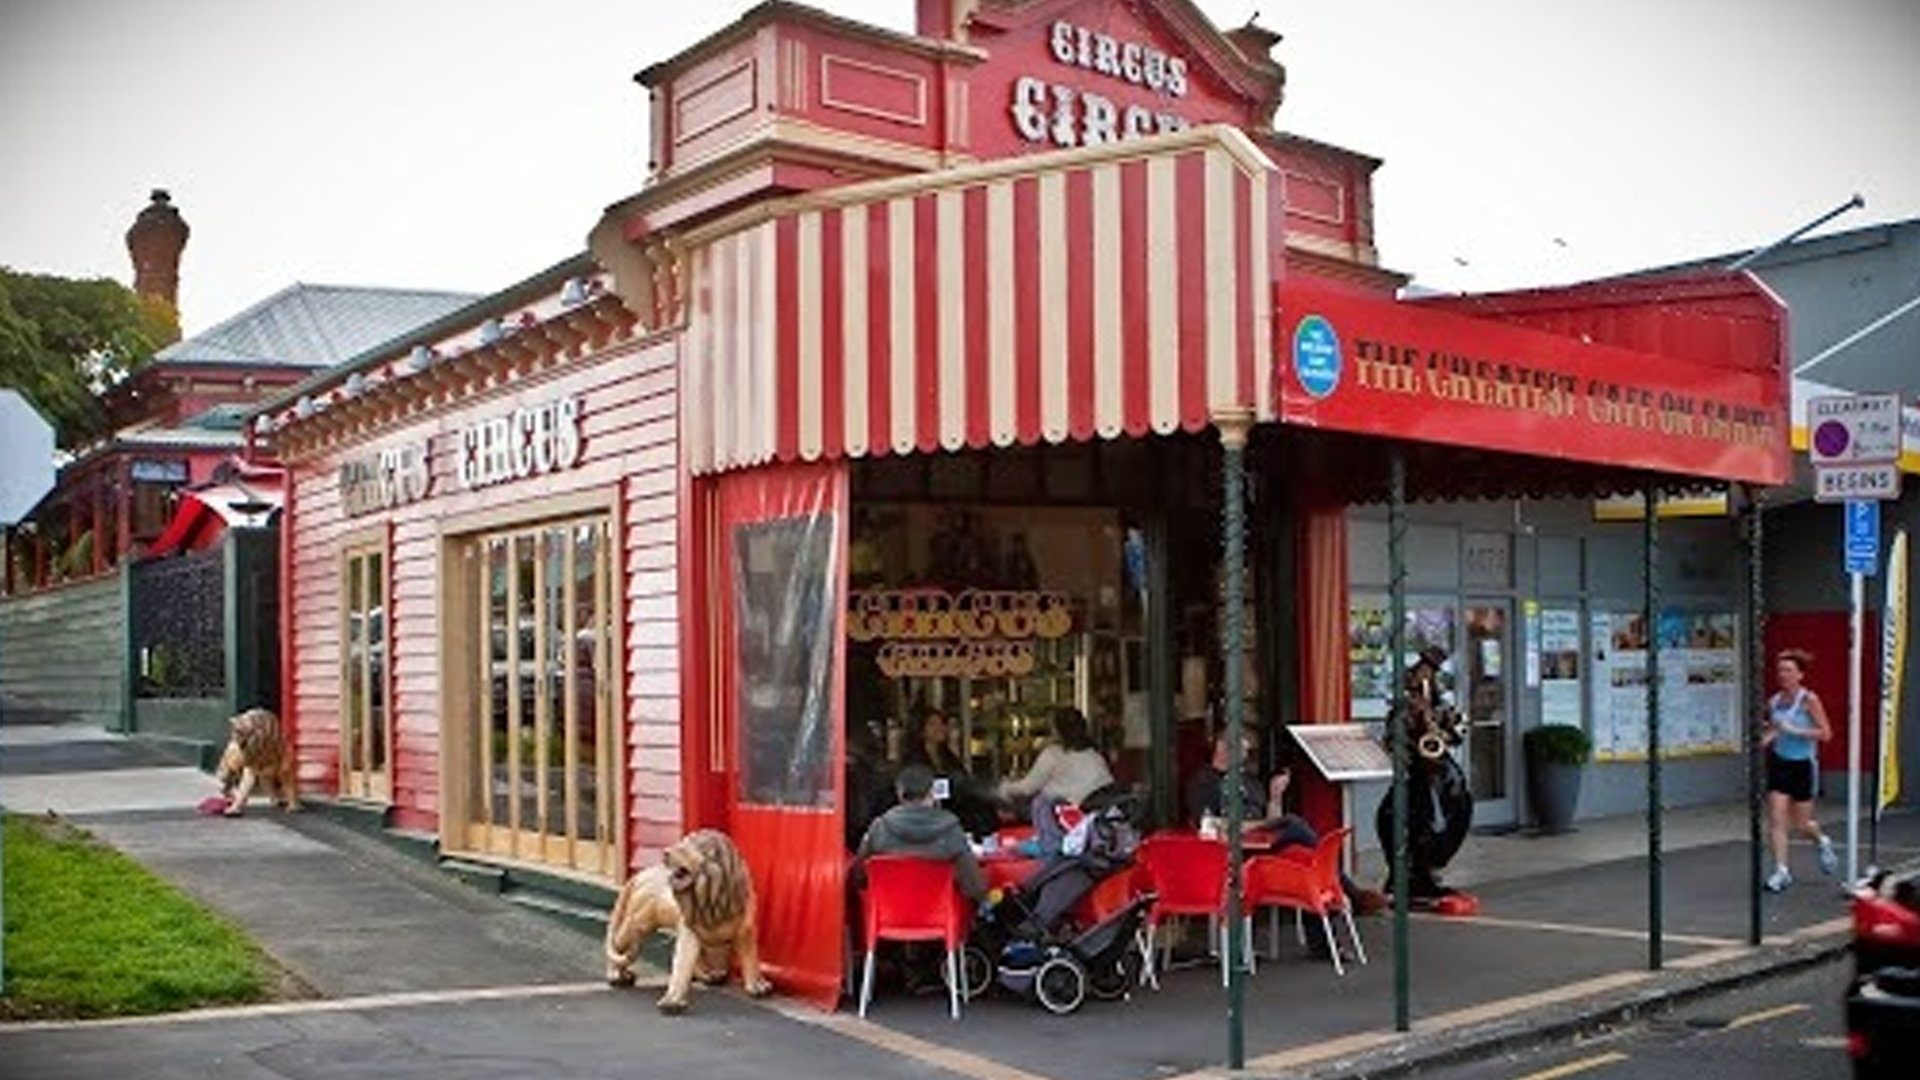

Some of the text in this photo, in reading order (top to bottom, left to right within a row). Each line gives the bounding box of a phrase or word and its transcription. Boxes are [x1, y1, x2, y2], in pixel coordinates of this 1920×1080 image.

[1051, 20, 1187, 96] CIRCUS
[1355, 338, 1422, 395] THE
[1427, 352, 1577, 417] GREATEST
[1586, 379, 1653, 431] CAFE
[1660, 391, 1697, 437] ON
[459, 397, 581, 490] CIRCUS
[1823, 472, 1889, 492] BEGINS
[847, 589, 1073, 641] CIRCUS
